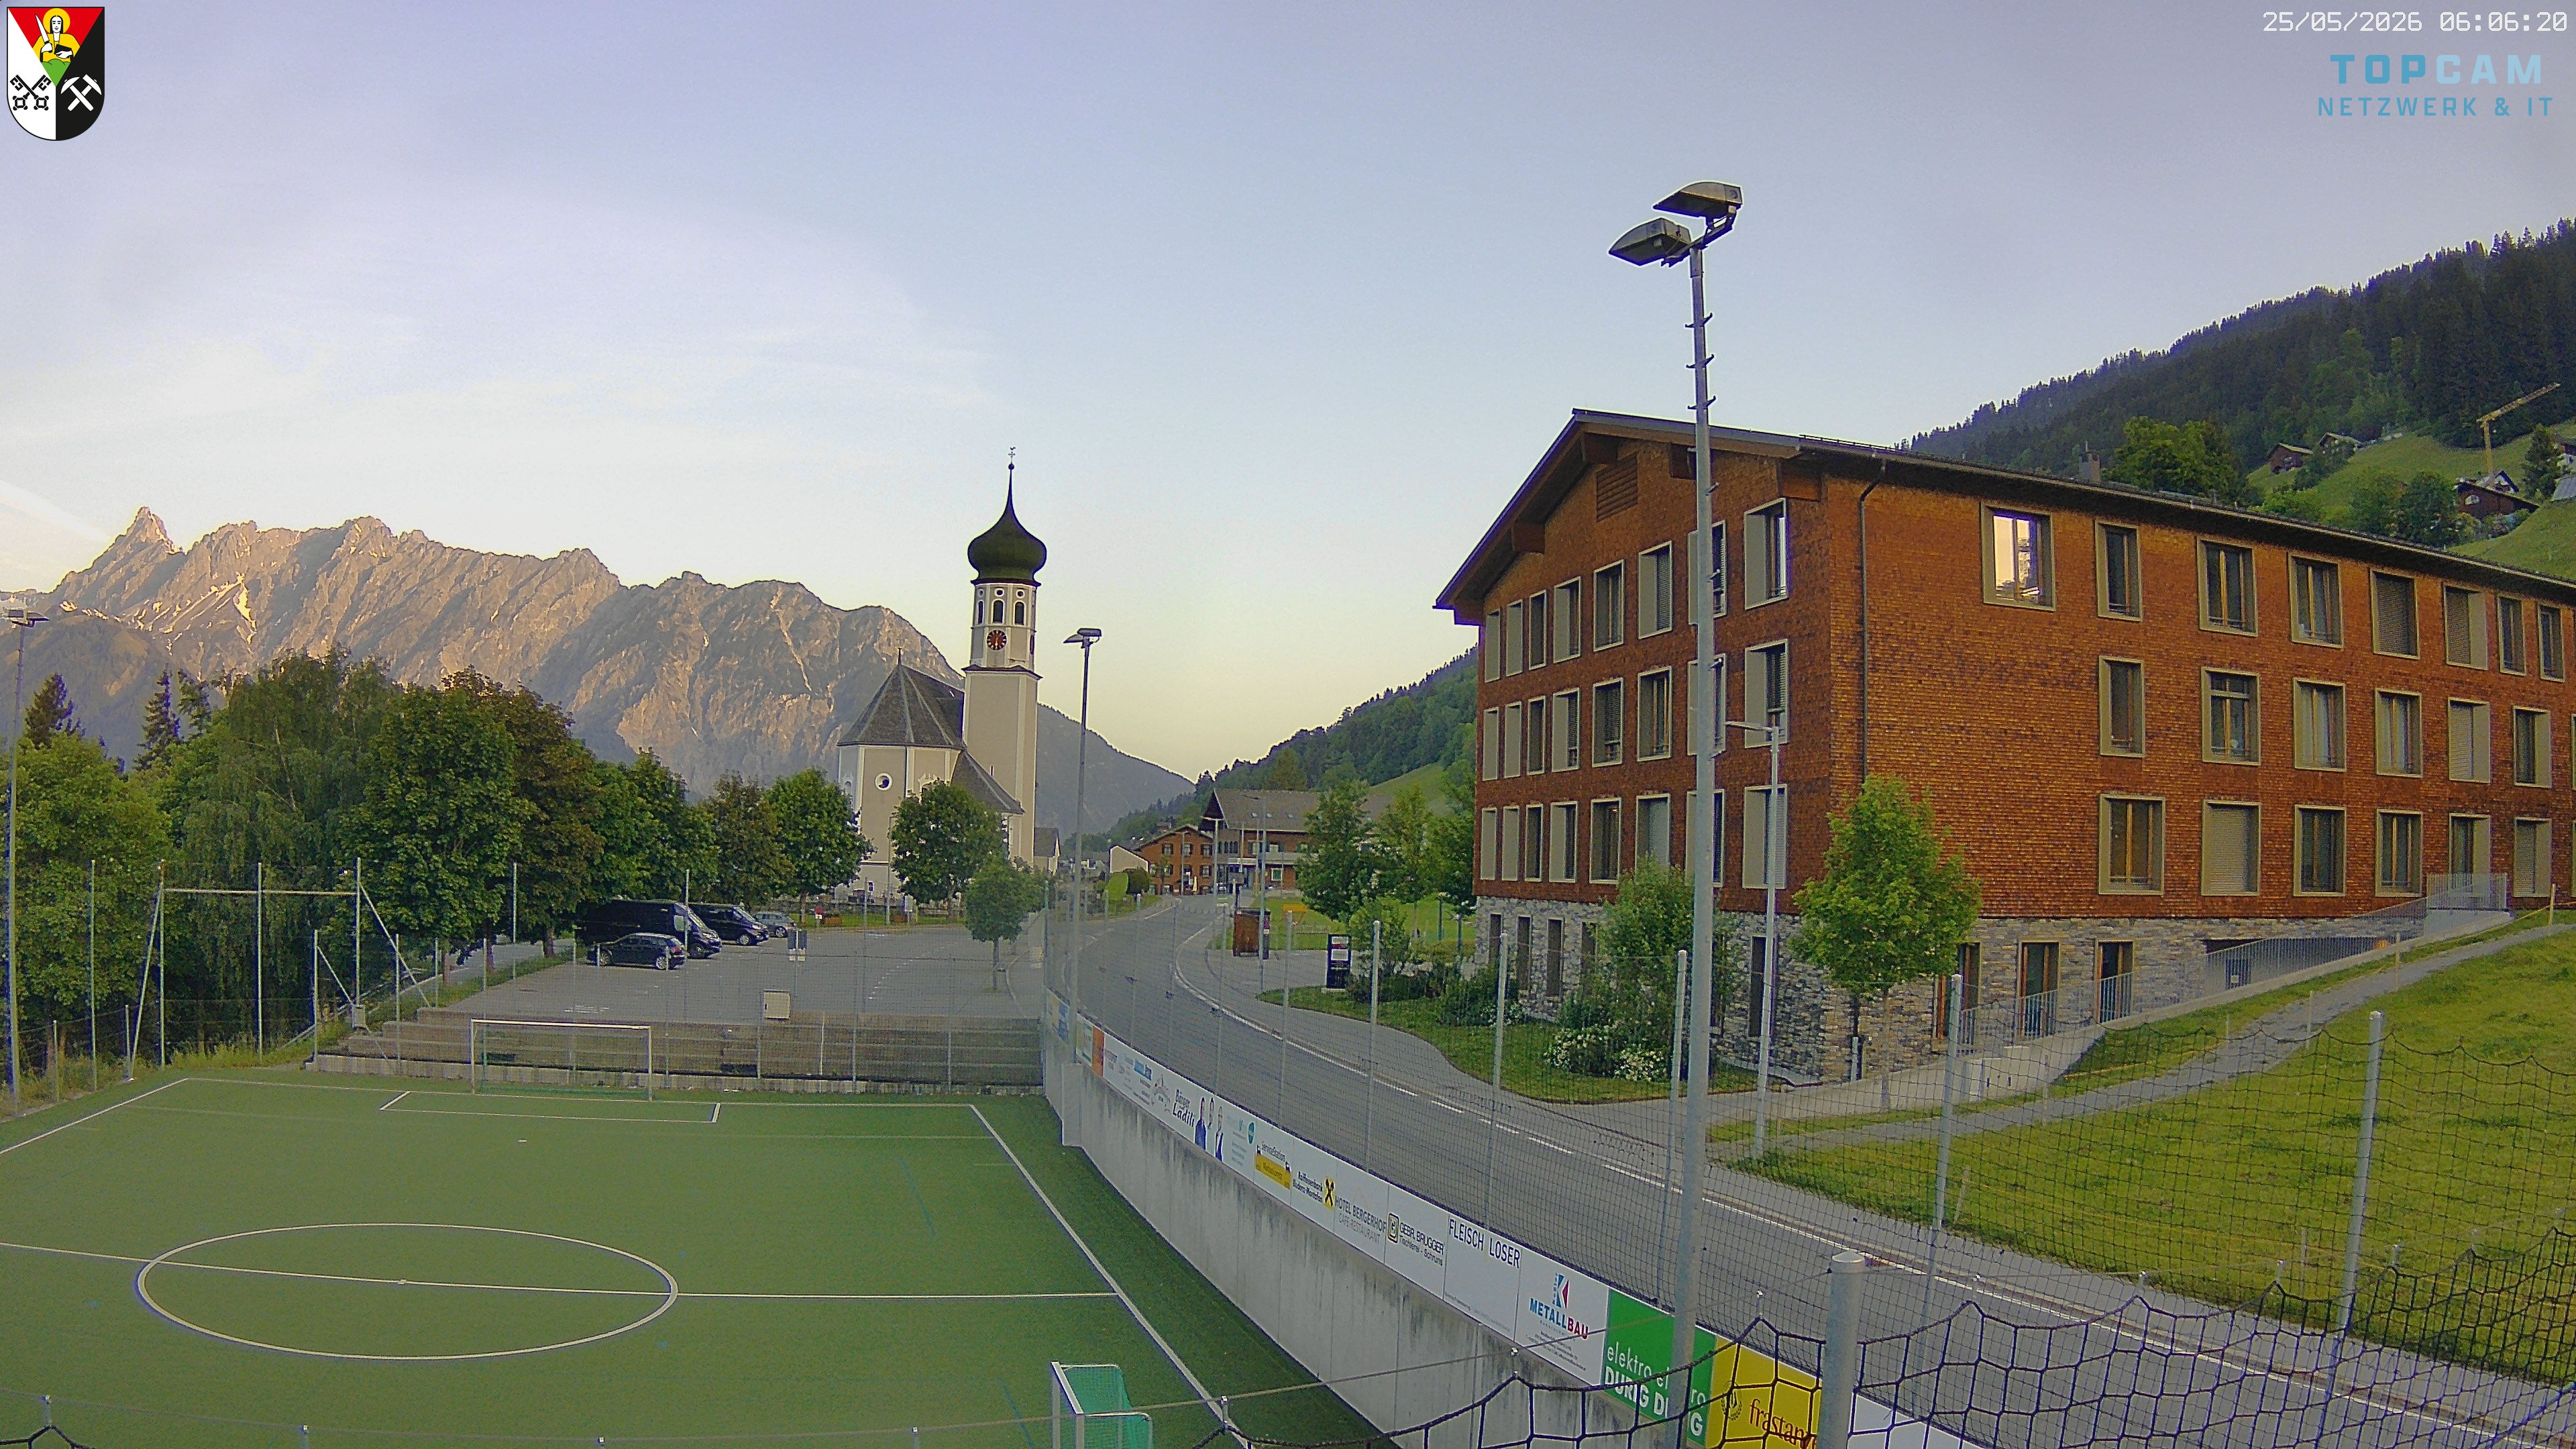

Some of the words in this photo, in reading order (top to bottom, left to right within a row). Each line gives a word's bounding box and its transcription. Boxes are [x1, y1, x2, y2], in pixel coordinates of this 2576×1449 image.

[1335, 1195, 1351, 1215] HOTEL
[1352, 1205, 1387, 1233] BERGERHOF
[1449, 1218, 1485, 1251] FLEISCH
[1489, 1238, 1521, 1269] LOSER
[1529, 1297, 1589, 1340] METALLBAU
[1607, 1341, 1652, 1379] elektro
